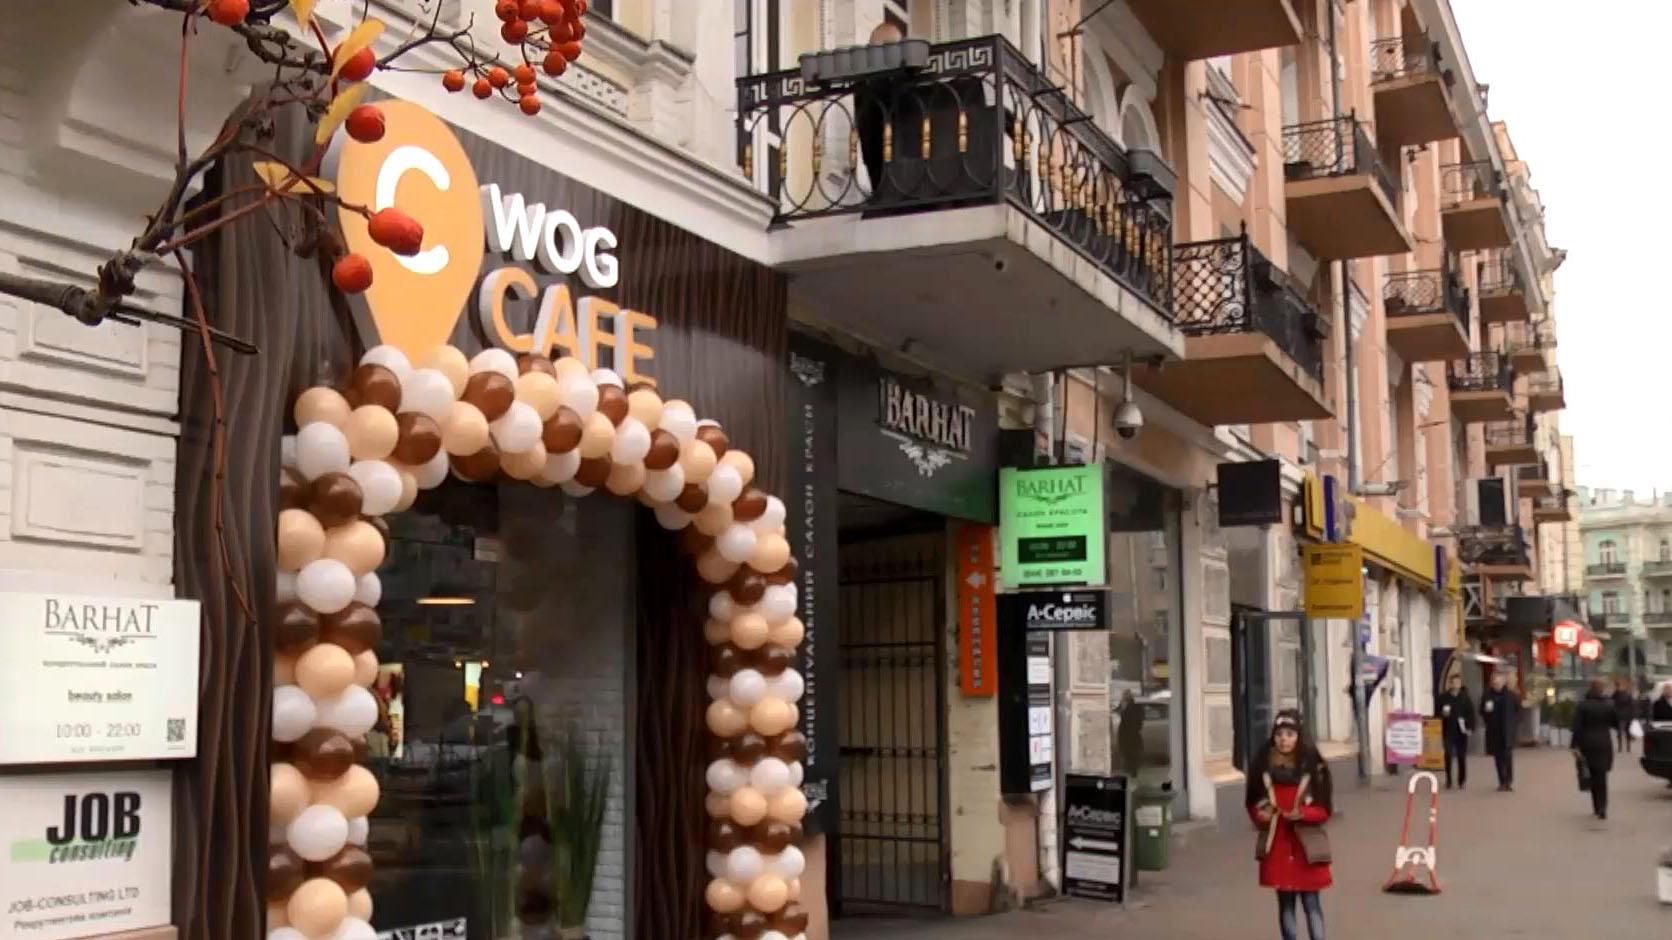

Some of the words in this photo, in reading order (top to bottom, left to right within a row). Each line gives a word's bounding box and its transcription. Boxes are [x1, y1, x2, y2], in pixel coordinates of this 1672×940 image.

[482, 183, 618, 288] WOG
[480, 266, 657, 388] CAFE
[881, 380, 976, 451] BARHAT
[1016, 475, 1088, 497] BARHAT
[44, 598, 159, 633] BARHAT
[68, 690, 103, 703] beauty
[106, 691, 133, 702] salon
[46, 791, 141, 846] JOB
[49, 837, 138, 864] consulting
[118, 886, 140, 901] LTD
